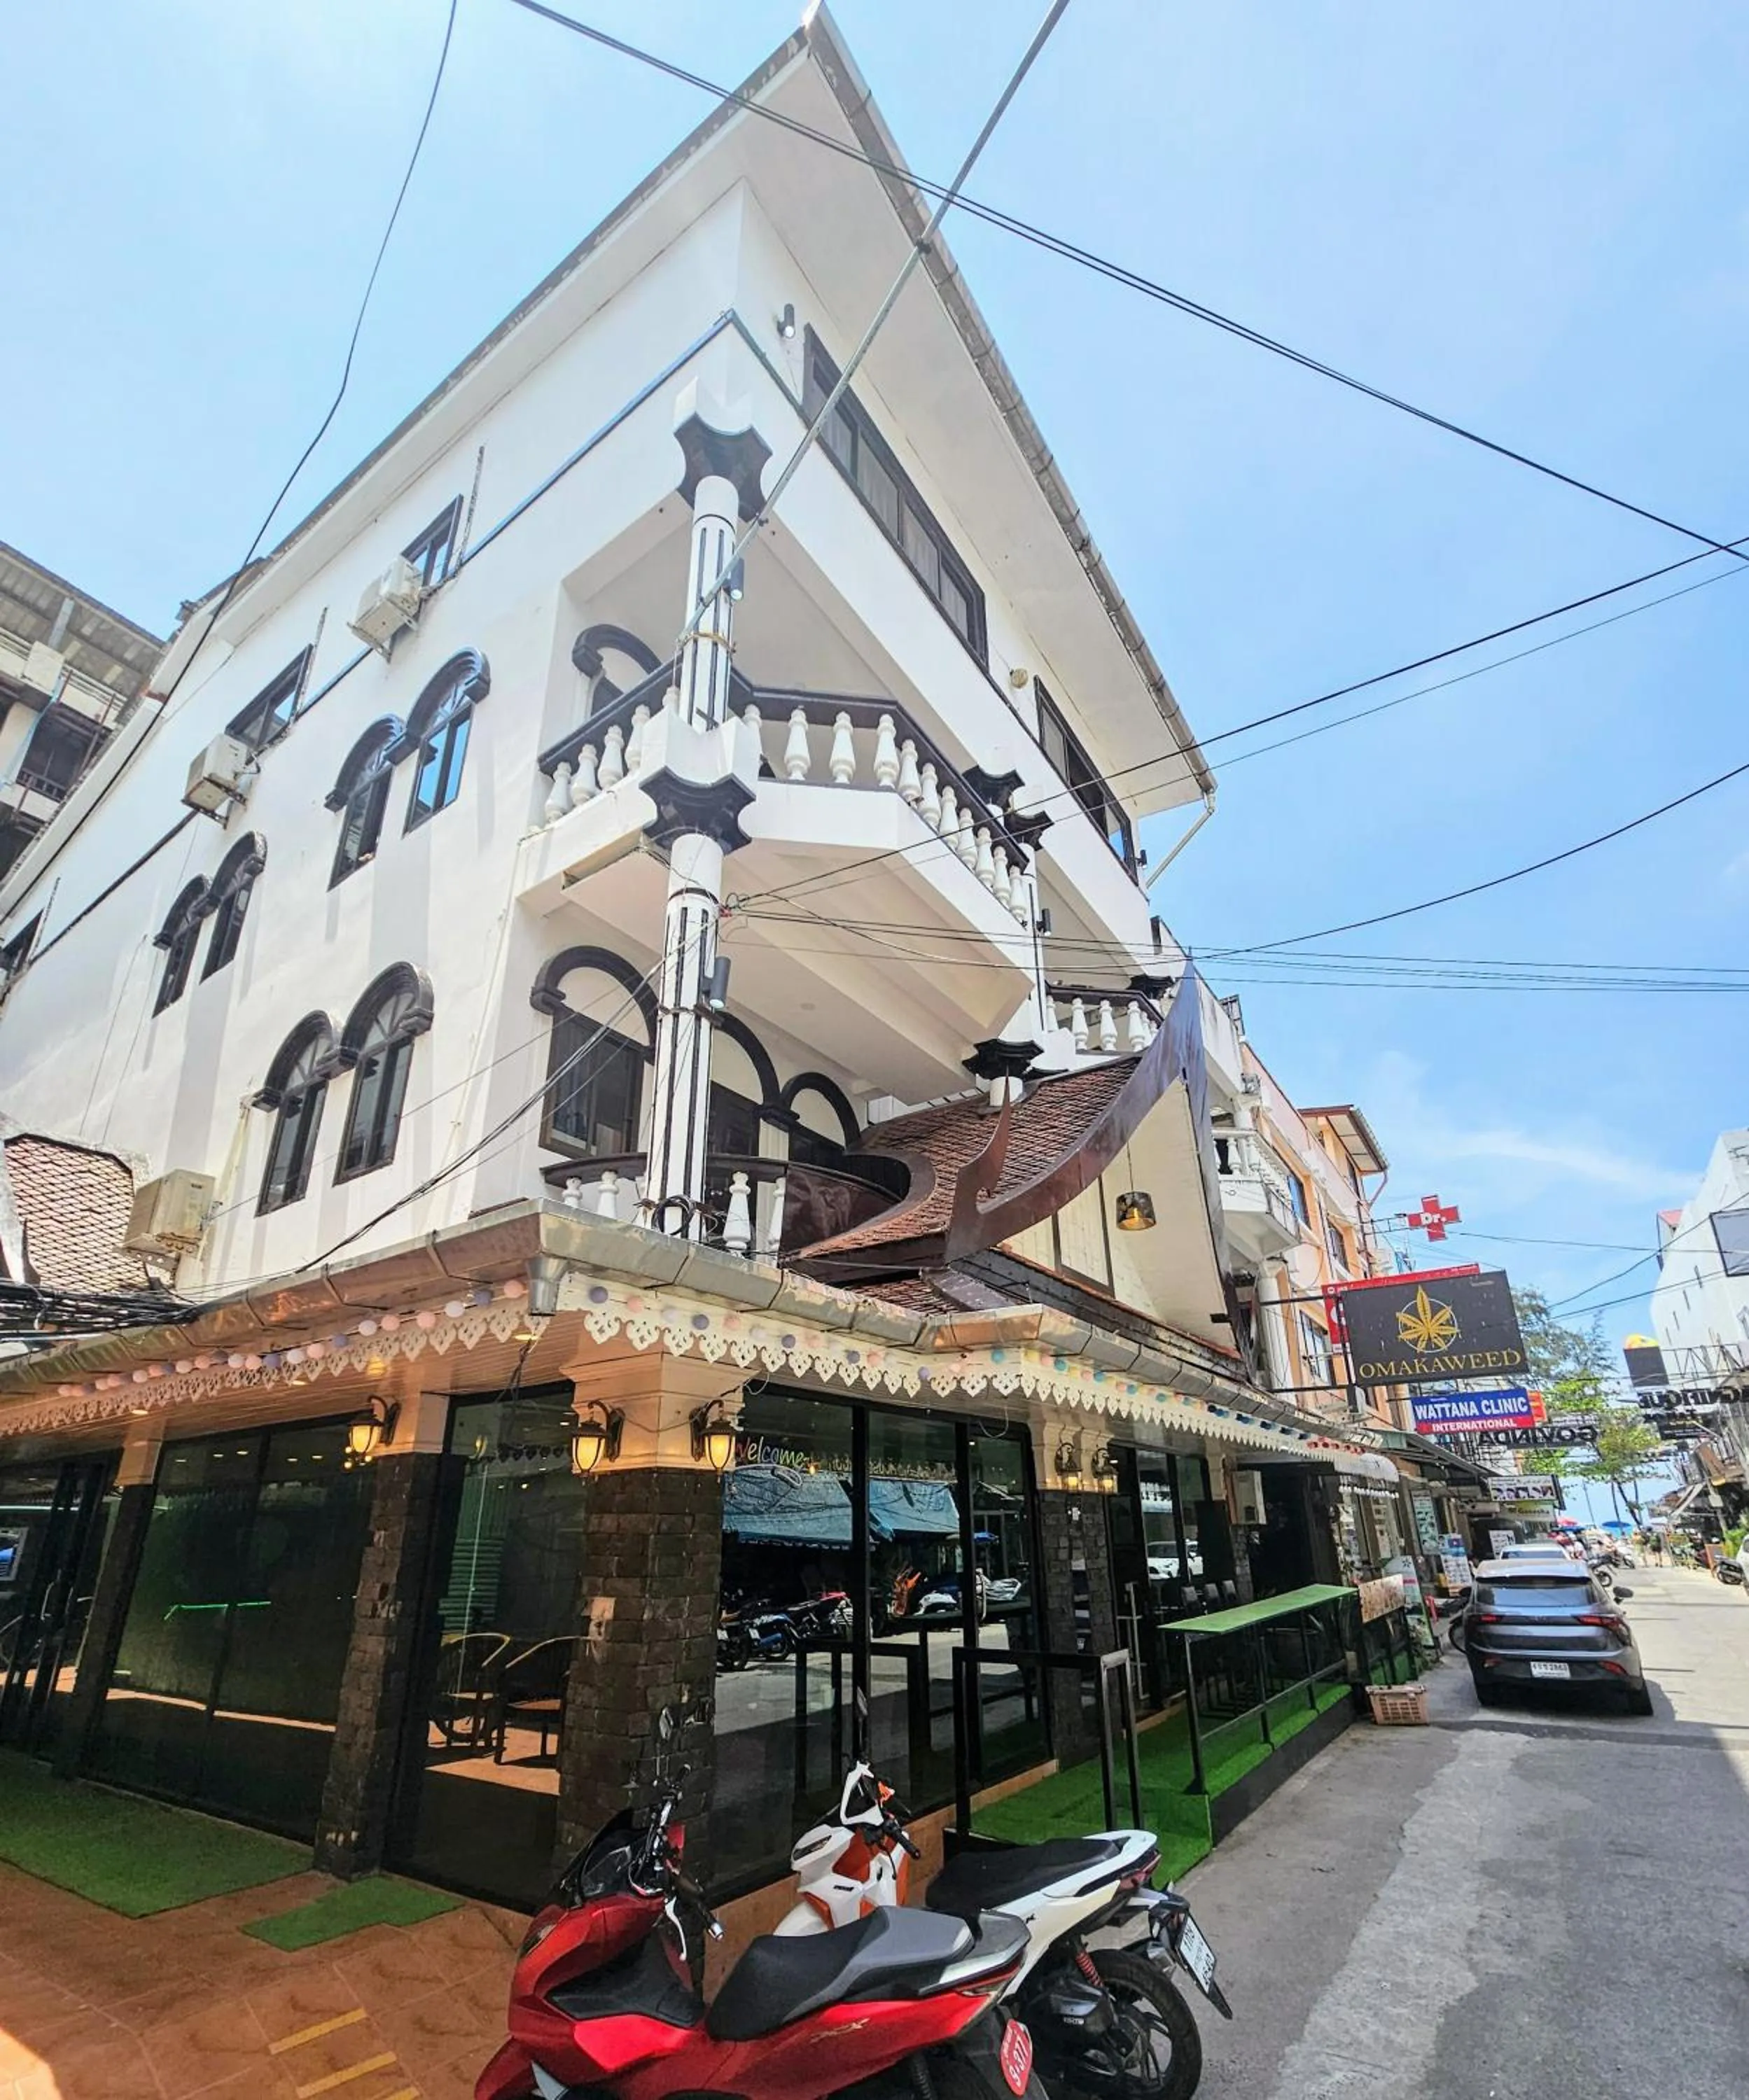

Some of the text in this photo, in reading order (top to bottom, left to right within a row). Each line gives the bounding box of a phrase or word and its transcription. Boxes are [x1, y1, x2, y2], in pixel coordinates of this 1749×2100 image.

[1420, 1212, 1447, 1225] Dr.
[1359, 1350, 1521, 1378] OMAKAWEED
[1415, 1396, 1528, 1420] WATTANA CLINIC
[1432, 1418, 1517, 1432] INTERNATIONAL
